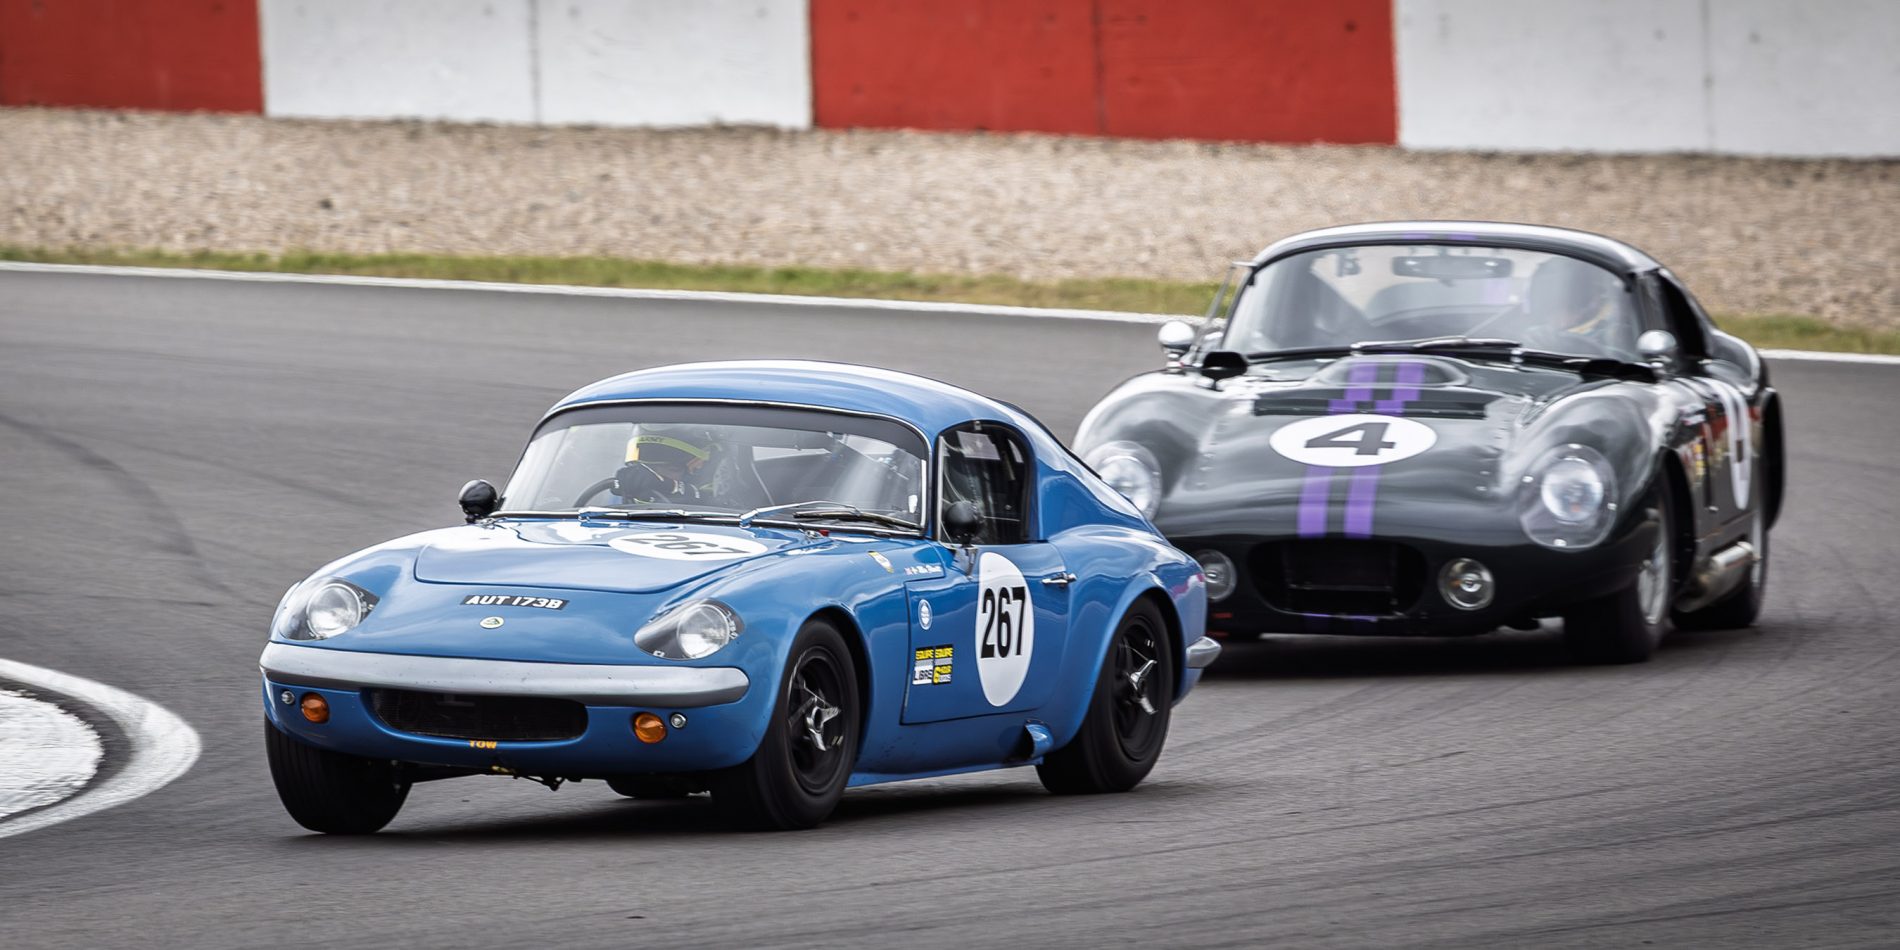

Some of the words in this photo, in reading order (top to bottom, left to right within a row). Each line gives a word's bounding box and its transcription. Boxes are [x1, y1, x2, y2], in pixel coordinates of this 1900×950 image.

[1304, 422, 1396, 456] 4
[621, 534, 751, 555] 267
[465, 595, 510, 605] AUT
[511, 596, 564, 609] 173B
[980, 586, 1026, 659] 267
[469, 739, 497, 749] TOW
